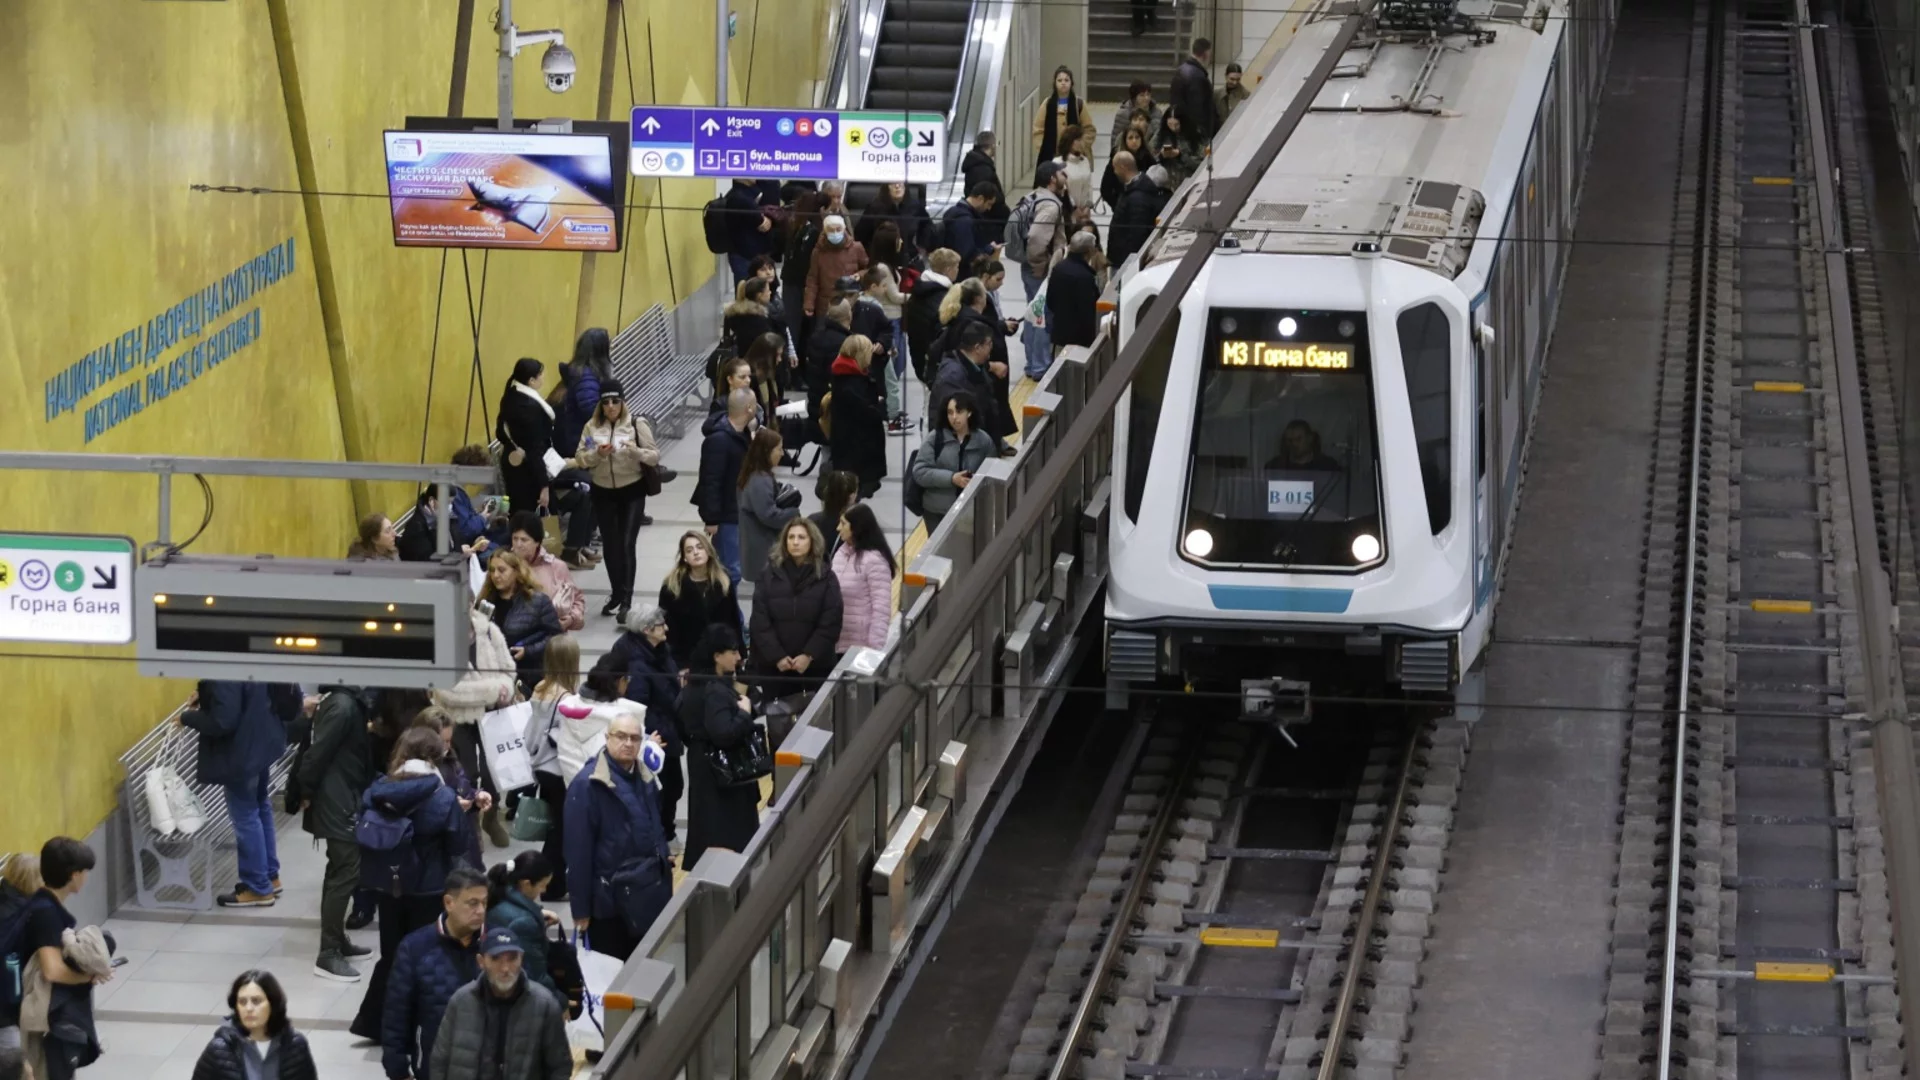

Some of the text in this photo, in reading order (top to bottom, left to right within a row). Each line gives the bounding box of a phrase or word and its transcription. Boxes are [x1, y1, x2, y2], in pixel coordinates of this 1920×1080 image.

[727, 116, 761, 129] Изход
[727, 130, 743, 138] Exit
[671, 157, 678, 167] 2
[706, 154, 714, 165] 3
[733, 155, 740, 165] 5
[750, 149, 822, 162] бул. Витоша
[861, 150, 937, 165] Горна баня
[394, 166, 485, 176] ЧЕСТИТО, СПЕЧЕЛИ
[750, 162, 800, 172] Vitosha Blvd
[395, 174, 495, 184] ЕКСКУРЗИЯ ДО МАРС
[45, 325, 142, 423] НАЦИОНАЛЕН
[144, 293, 201, 369] ДВОРЕЦ
[202, 281, 221, 328] НА
[222, 243, 286, 313] КУЛТУРАТА
[1223, 342, 1349, 369] M3 Горна баня
[84, 380, 145, 445] NATIONAL
[146, 354, 191, 408] PALACE
[191, 340, 207, 380] OF
[207, 311, 254, 371] CULTURE
[1285, 490, 1313, 505] 015
[64, 570, 75, 583] 3
[10, 594, 121, 615] Горна баня
[496, 737, 525, 754] BLS
